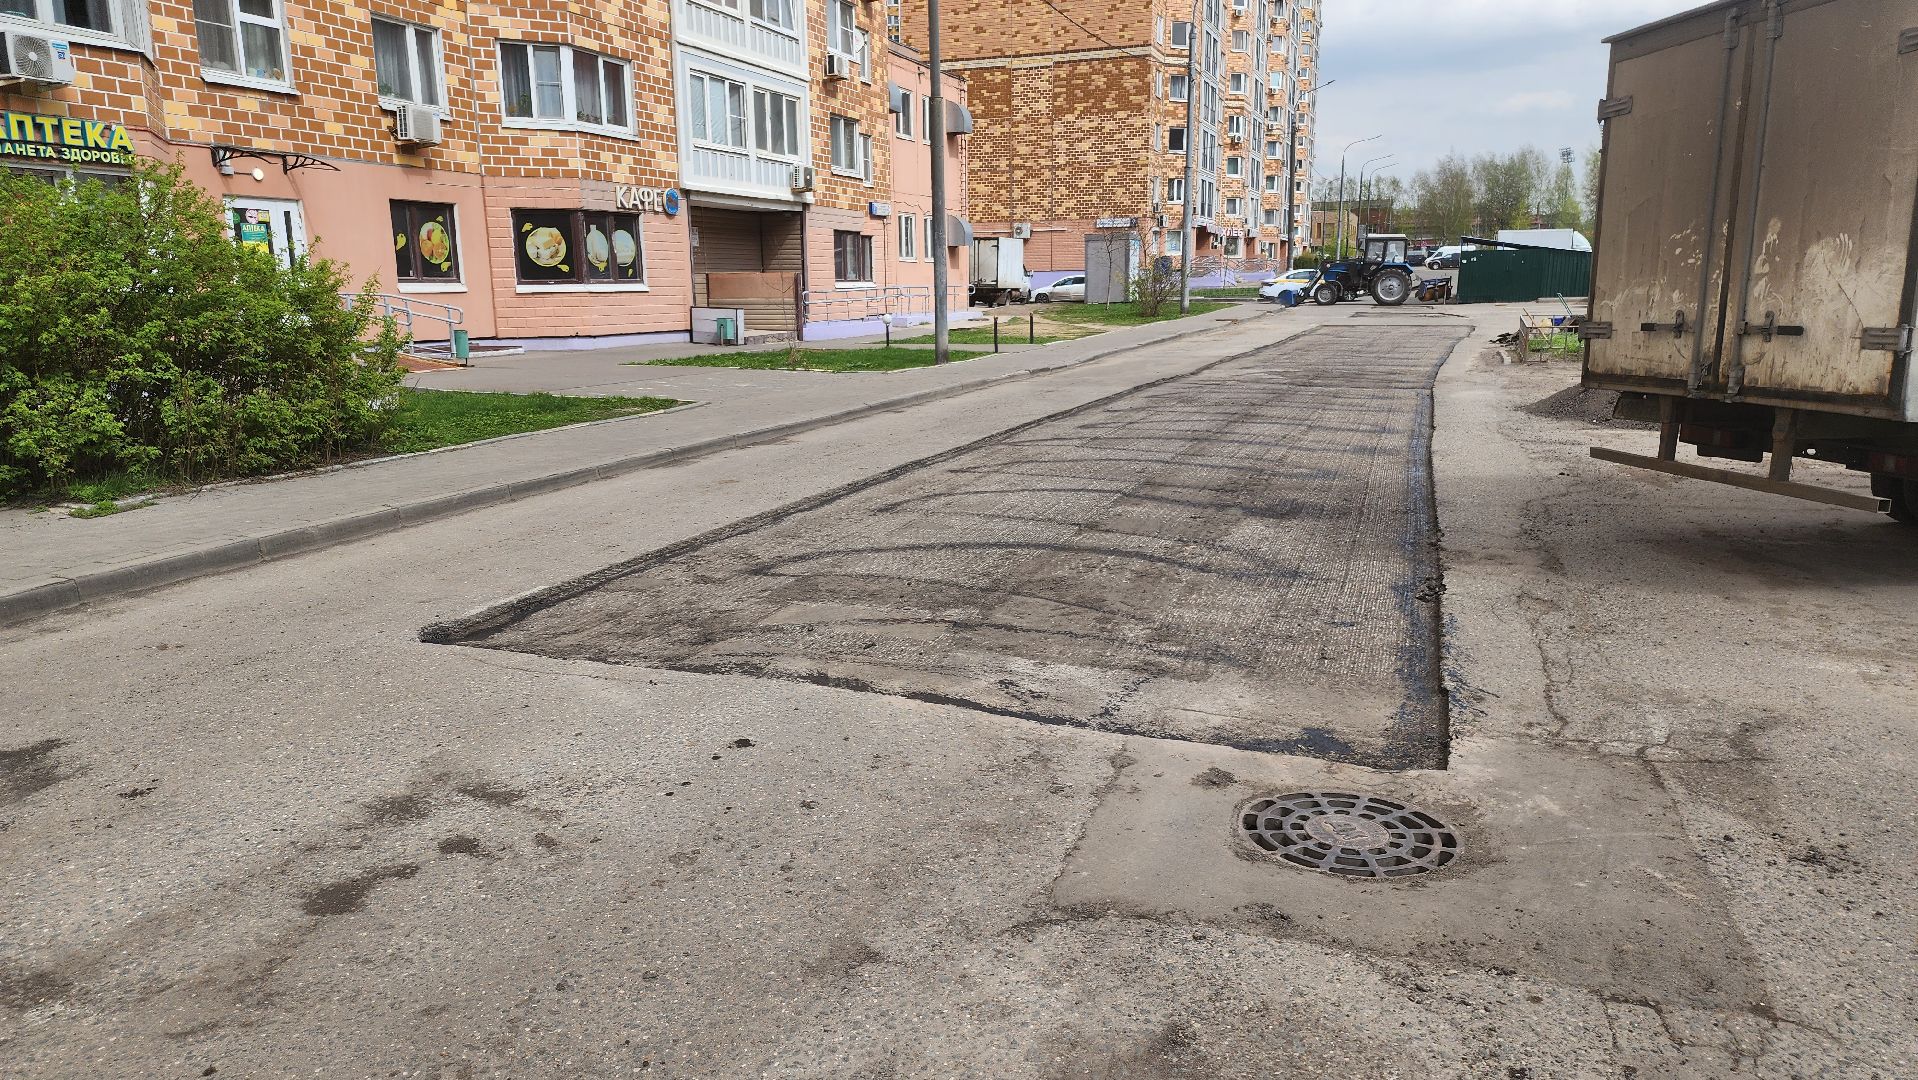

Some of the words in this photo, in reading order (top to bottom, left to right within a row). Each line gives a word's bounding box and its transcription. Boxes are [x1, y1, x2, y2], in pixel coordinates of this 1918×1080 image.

[0, 142, 57, 159] АНЕТА
[615, 185, 663, 212] КАФЕ
[1220, 228, 1243, 237] ХЛЕБ
